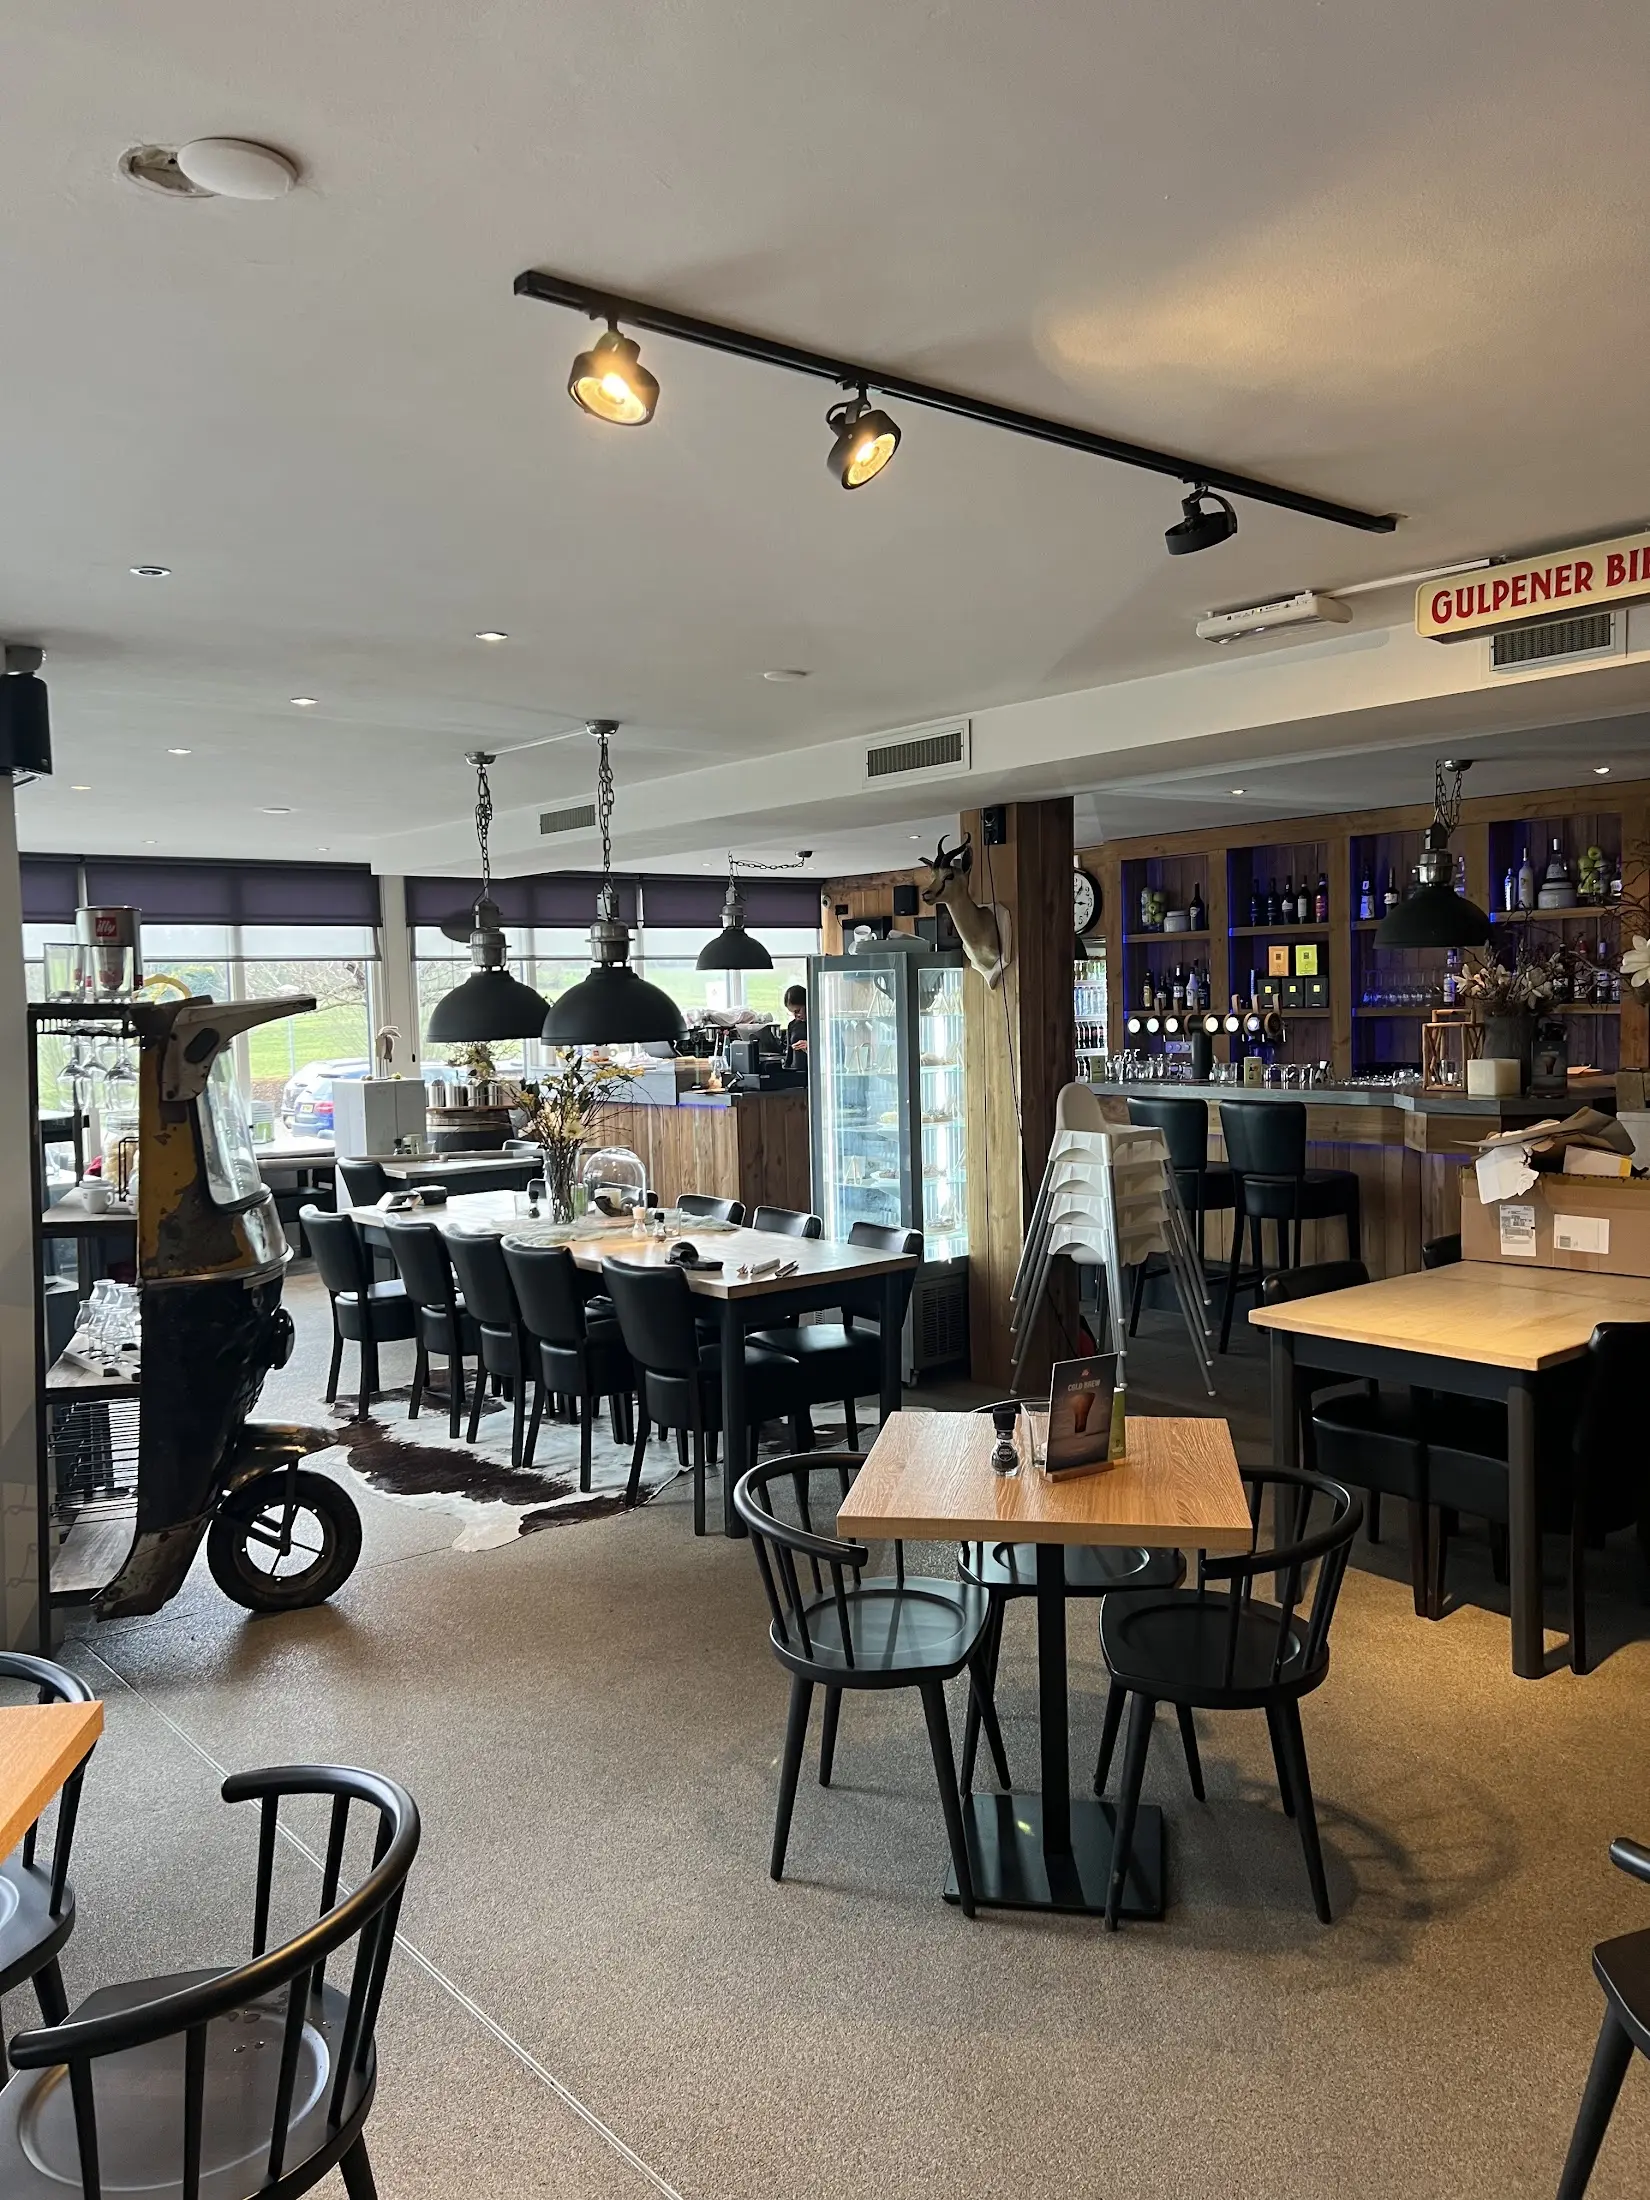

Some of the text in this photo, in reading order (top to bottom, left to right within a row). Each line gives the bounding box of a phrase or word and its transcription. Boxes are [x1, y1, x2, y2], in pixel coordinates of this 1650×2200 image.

[1431, 561, 1594, 625] GULPENER
[1084, 886, 1090, 897] 2
[1087, 897, 1093, 908] 3
[1084, 907, 1090, 918] 4
[1078, 915, 1084, 925] 5
[96, 919, 116, 935] illy
[1067, 1379, 1101, 1392] COLD BREW
